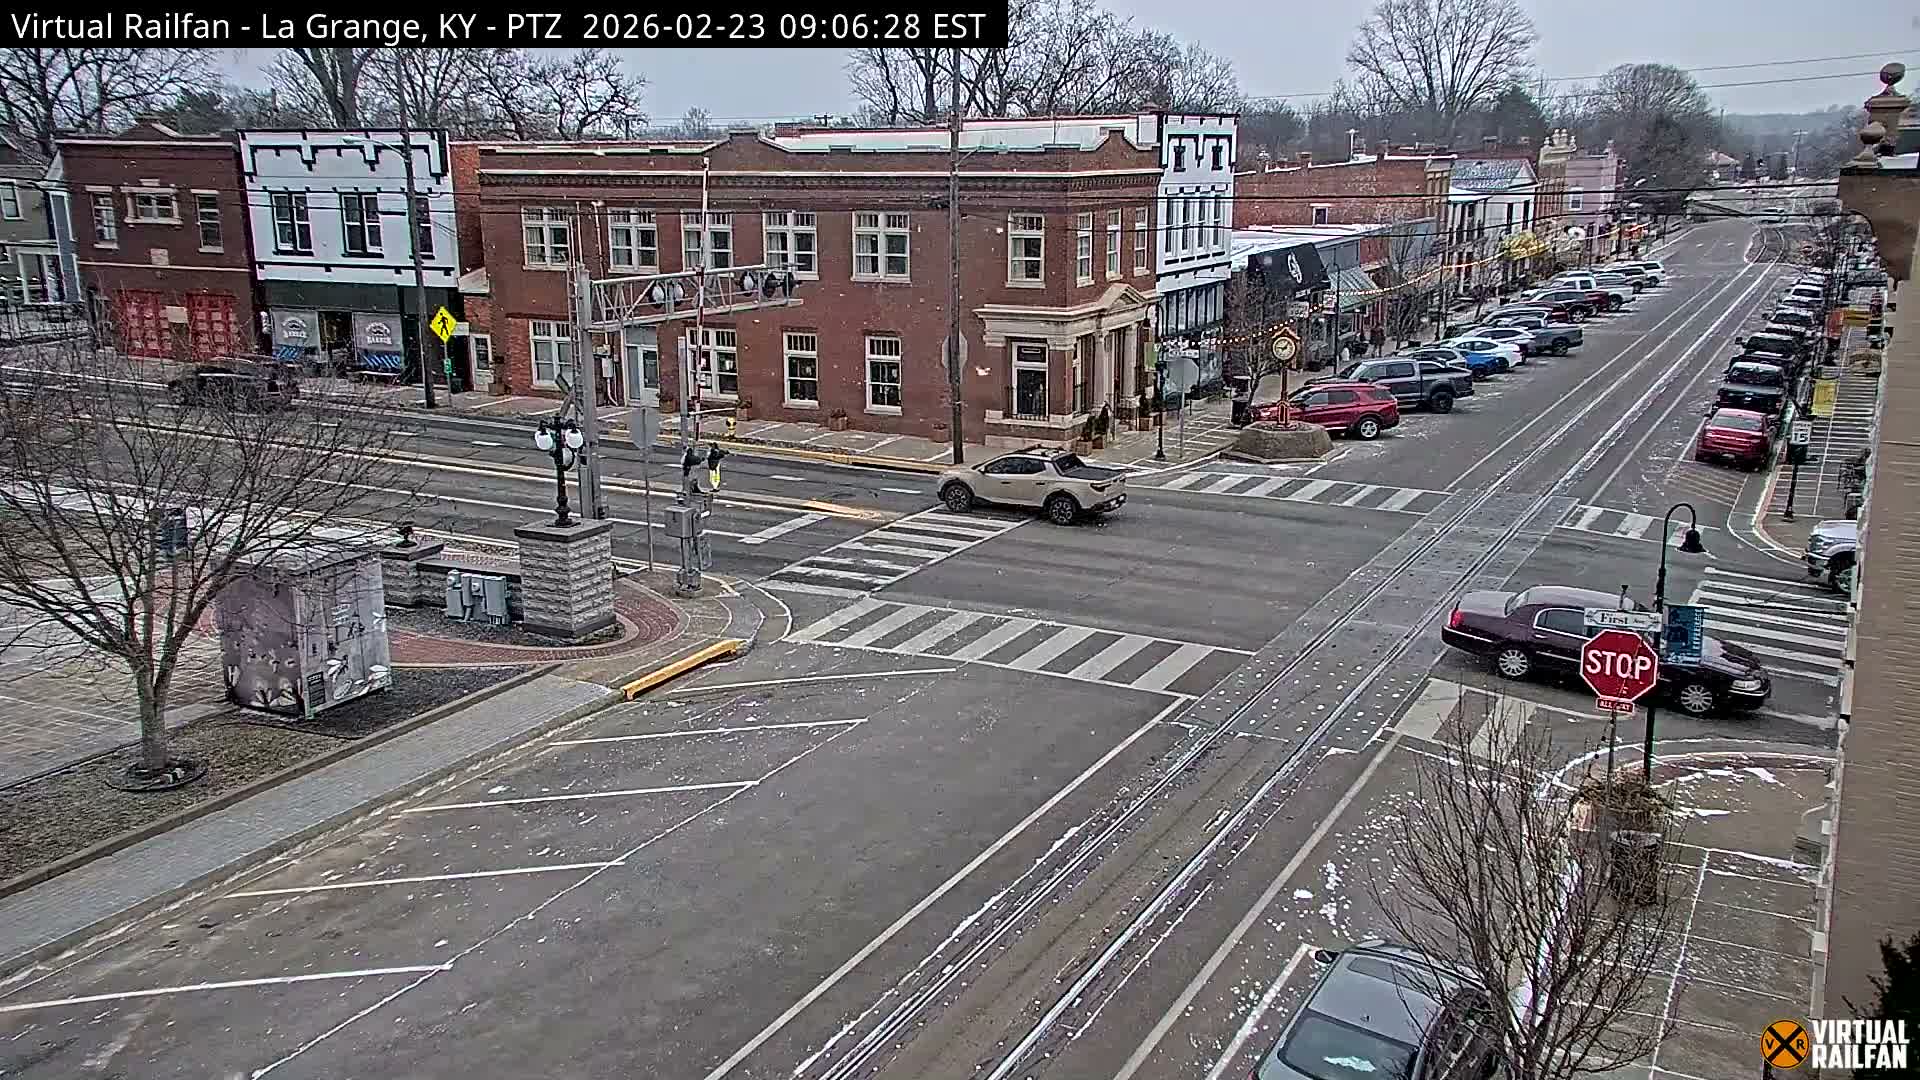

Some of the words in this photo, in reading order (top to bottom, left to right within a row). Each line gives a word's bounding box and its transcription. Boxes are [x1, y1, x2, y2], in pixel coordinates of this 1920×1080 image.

[1794, 433, 1808, 442] 15
[1600, 613, 1628, 625] First
[1585, 649, 1652, 680] STOP
[1615, 702, 1631, 711] AY
